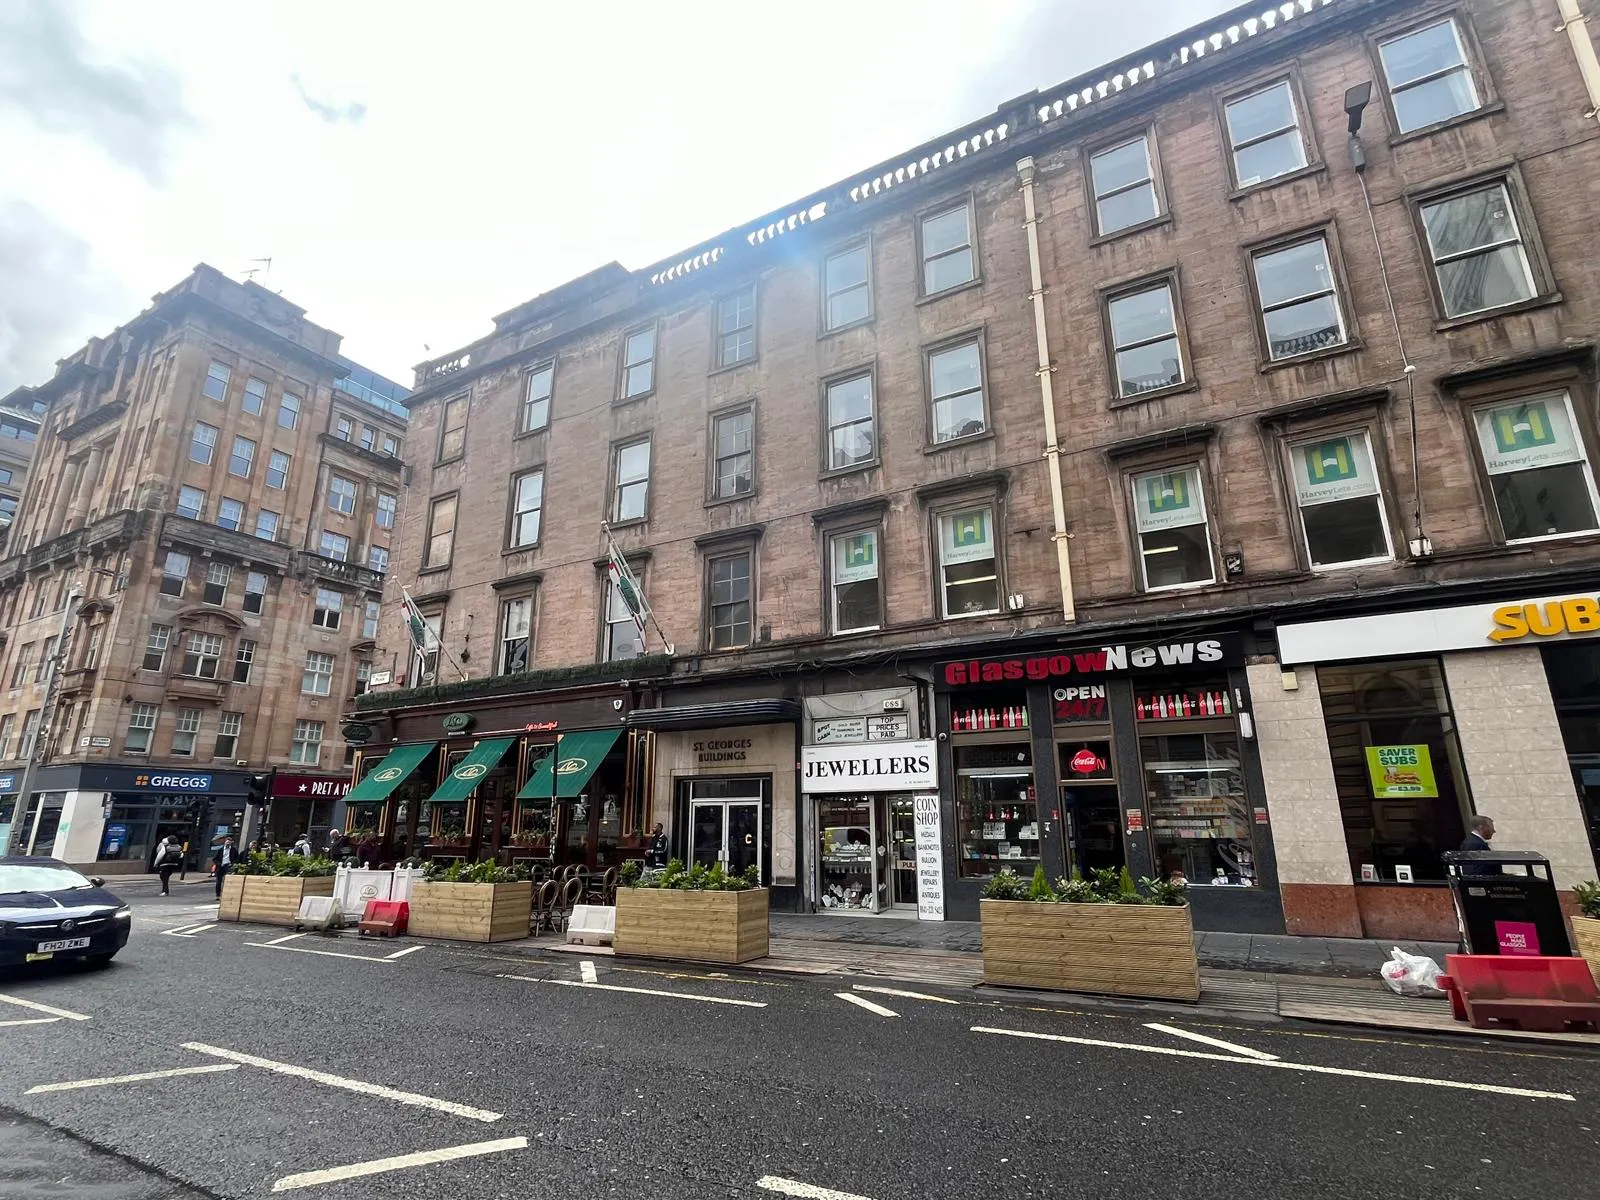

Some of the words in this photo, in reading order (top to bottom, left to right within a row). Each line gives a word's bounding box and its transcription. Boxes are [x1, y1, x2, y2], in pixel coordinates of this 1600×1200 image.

[1486, 597, 1600, 643] SUB
[1101, 640, 1223, 671] News
[1054, 685, 1105, 701] OPEN
[876, 724, 900, 732] PRICES
[707, 739, 752, 750] GEORGES
[698, 751, 746, 762] BUILDINGS
[1379, 748, 1416, 757] SAVER
[805, 755, 930, 777] JEWELLERS
[1381, 756, 1418, 766] SUBS
[151, 776, 207, 788] GREGGS
[312, 782, 333, 795] PRET
[333, 784, 340, 795] A
[916, 798, 937, 811] COIN
[916, 812, 938, 826] SHOP
[44, 941, 65, 951] FH21
